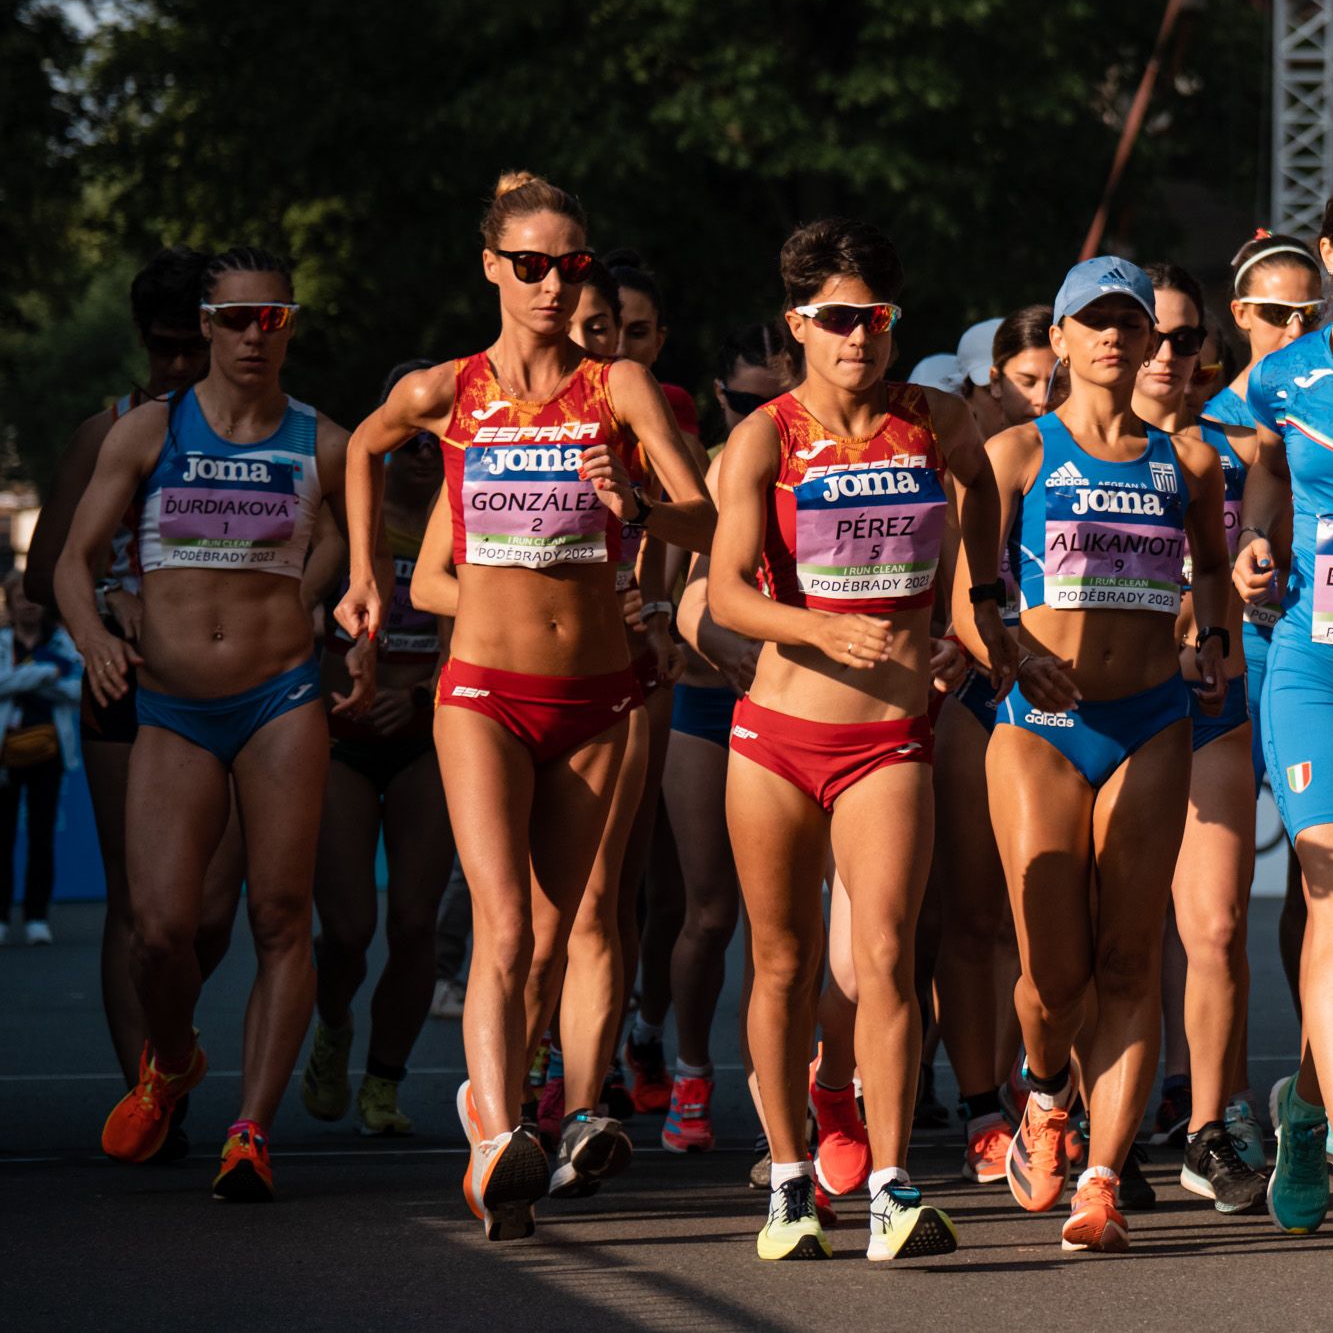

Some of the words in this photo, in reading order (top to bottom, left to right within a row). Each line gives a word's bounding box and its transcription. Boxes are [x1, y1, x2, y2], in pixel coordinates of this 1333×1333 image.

[472, 422, 600, 443] ESPAÑA
[1045, 477, 1090, 487] adidas
[1097, 481, 1139, 489] AEGEAN
[165, 496, 289, 517] ĎURDIAKOVÁ
[472, 487, 601, 511] GONZÁLEZ
[222, 522, 229, 535] 1
[531, 517, 543, 532] 2
[836, 513, 915, 540] PÉREZ
[222, 540, 253, 548] CLEAN
[513, 537, 533, 546] RUN
[1050, 533, 1182, 558] ALIKANIOTI
[173, 549, 248, 563] PODĚBRADY
[250, 551, 276, 563] 2023
[478, 547, 561, 562] PODĚBRADY
[564, 547, 594, 560] 2023
[870, 544, 881, 560] 5
[849, 566, 872, 575] RUN
[873, 565, 906, 574] CLEAN
[1114, 559, 1125, 573] 9
[811, 578, 901, 592] PODĚBRADY
[905, 575, 929, 589] 2023
[1095, 578, 1116, 586] RUN
[1118, 579, 1149, 587] CLEAN
[1058, 589, 1144, 603] PODĚBRADY
[1147, 593, 1175, 607] 2023
[452, 686, 490, 698] ESP
[1025, 712, 1074, 727] adidas
